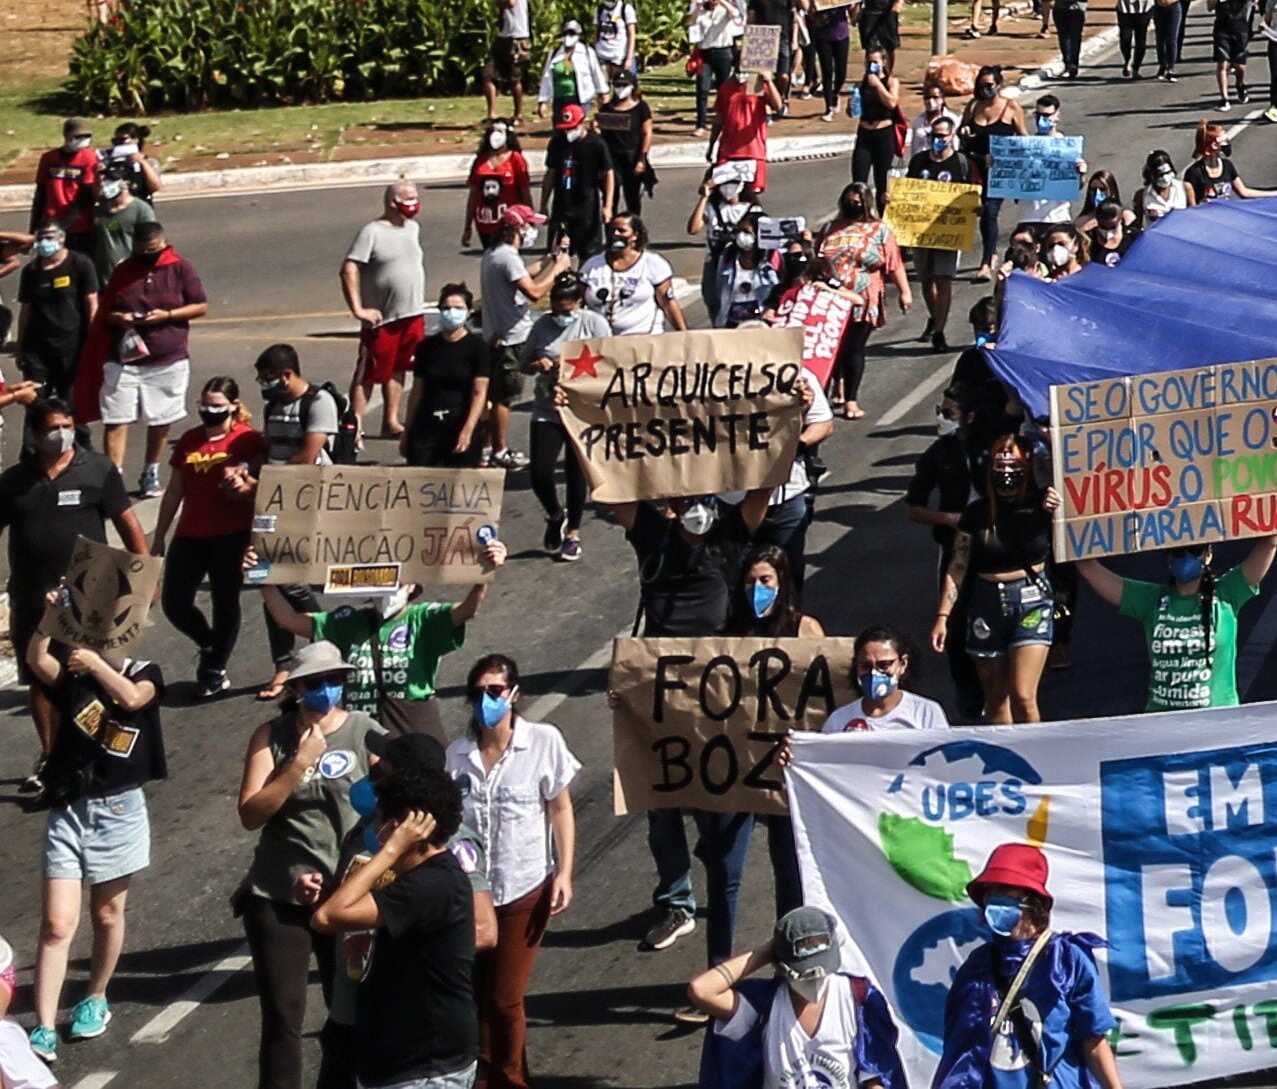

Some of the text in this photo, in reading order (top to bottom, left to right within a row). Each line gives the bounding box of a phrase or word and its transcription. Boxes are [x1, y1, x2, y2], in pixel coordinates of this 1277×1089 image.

[815, 294, 852, 360] PEOPLE
[1064, 384, 1100, 423] SE
[579, 411, 772, 462] PRESENTE
[1087, 423, 1163, 469] PIOR
[1169, 414, 1235, 461] QUE
[1243, 408, 1269, 450] O
[264, 472, 493, 512] A CIÊNCIA SALVA
[1180, 464, 1203, 502] O
[420, 516, 478, 567] JÁ
[1066, 517, 1114, 558] VAI
[1199, 505, 1225, 542] A
[1151, 639, 1183, 654] em
[652, 648, 837, 723] FORA
[1154, 668, 1212, 686] ar puro
[652, 730, 786, 795] BOZ
[921, 779, 1028, 822] UBES
[1162, 762, 1266, 836] EM
